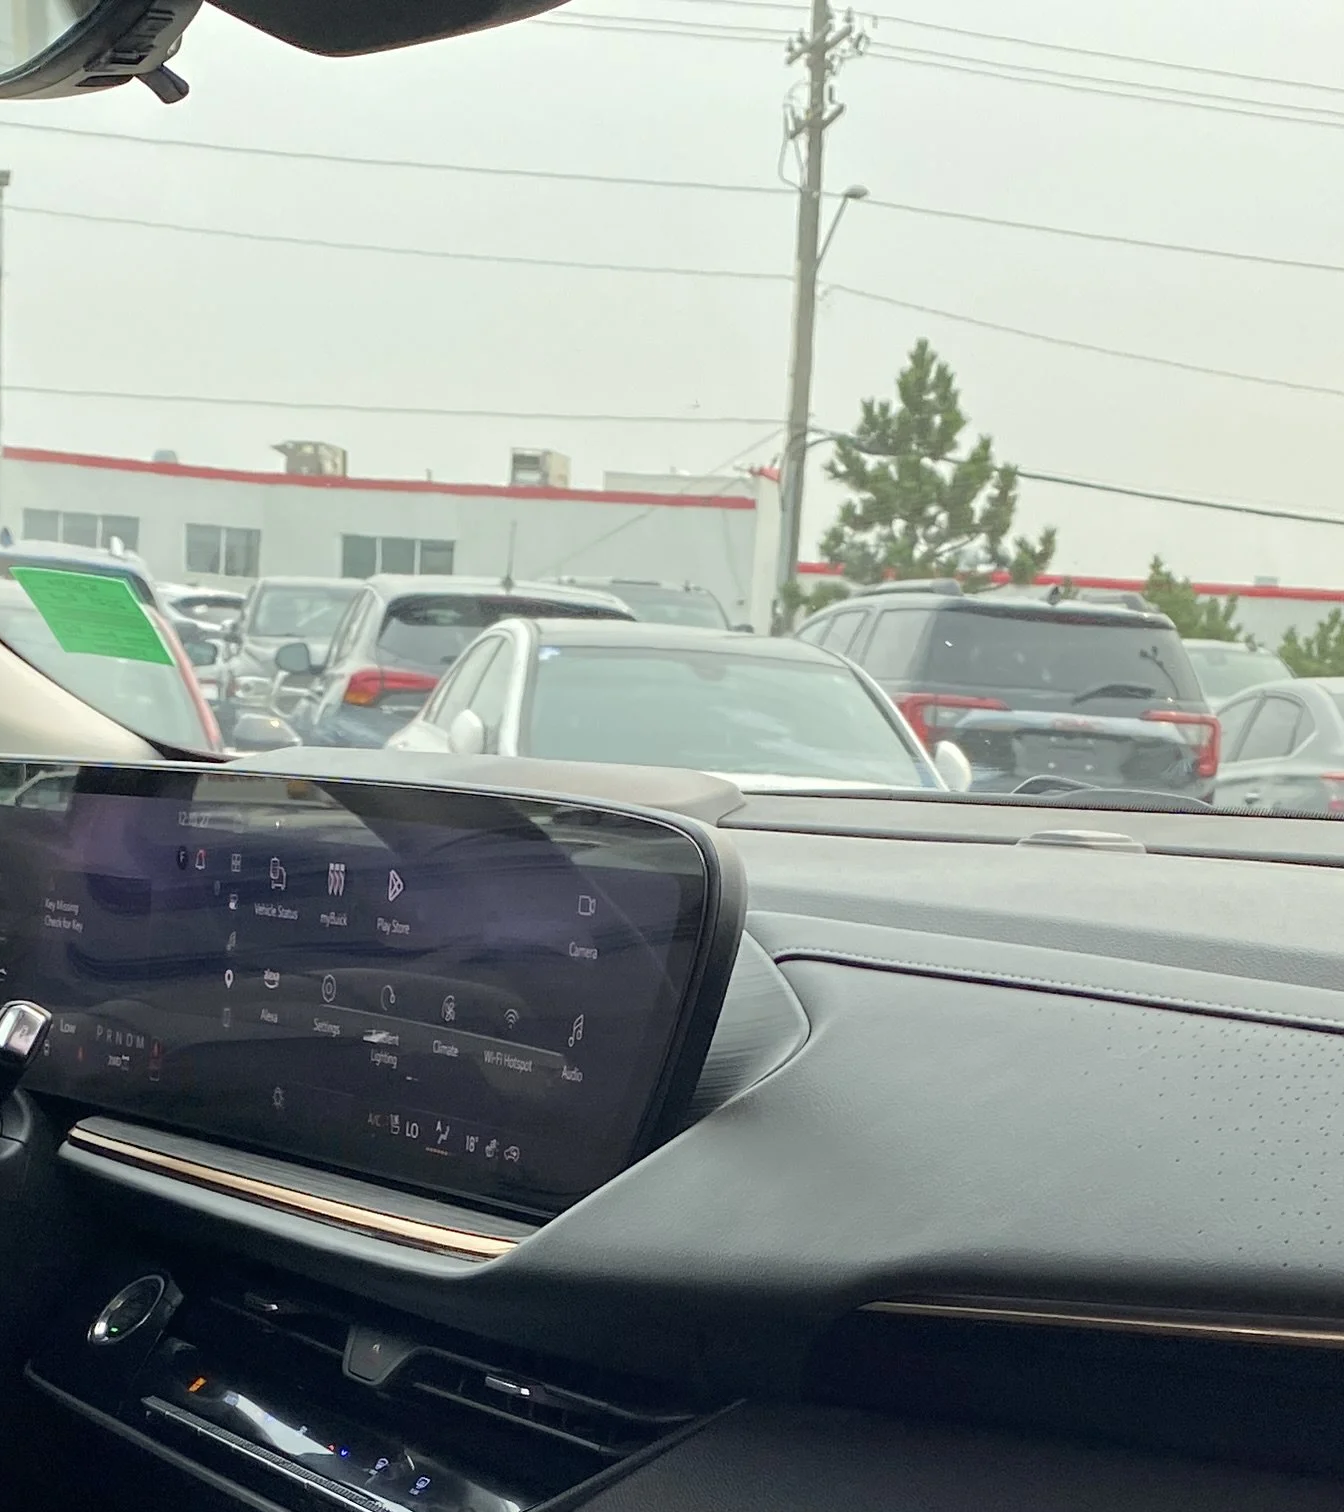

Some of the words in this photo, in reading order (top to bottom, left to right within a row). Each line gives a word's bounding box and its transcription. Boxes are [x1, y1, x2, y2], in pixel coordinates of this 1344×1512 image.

[45, 898, 56, 912] Key
[56, 900, 79, 916] Missing
[254, 903, 277, 918] Vehicle
[278, 904, 298, 921] Status
[44, 915, 62, 928] Check
[63, 917, 71, 929] for
[72, 919, 83, 934] Key
[320, 911, 347, 927] myBuick
[376, 917, 391, 935] Play
[391, 919, 410, 935] Store
[569, 941, 598, 960] Camera
[260, 1008, 278, 1024] Alexa
[60, 1018, 76, 1034] Low
[313, 1017, 341, 1038] Settings
[136, 1035, 144, 1049] M
[432, 1039, 459, 1057] Climate
[370, 1048, 398, 1069] Lighting
[484, 1049, 503, 1065] Wi-Fi
[503, 1054, 532, 1073] Hotspot
[561, 1065, 583, 1082] Audio
[405, 1120, 419, 1139] LO
